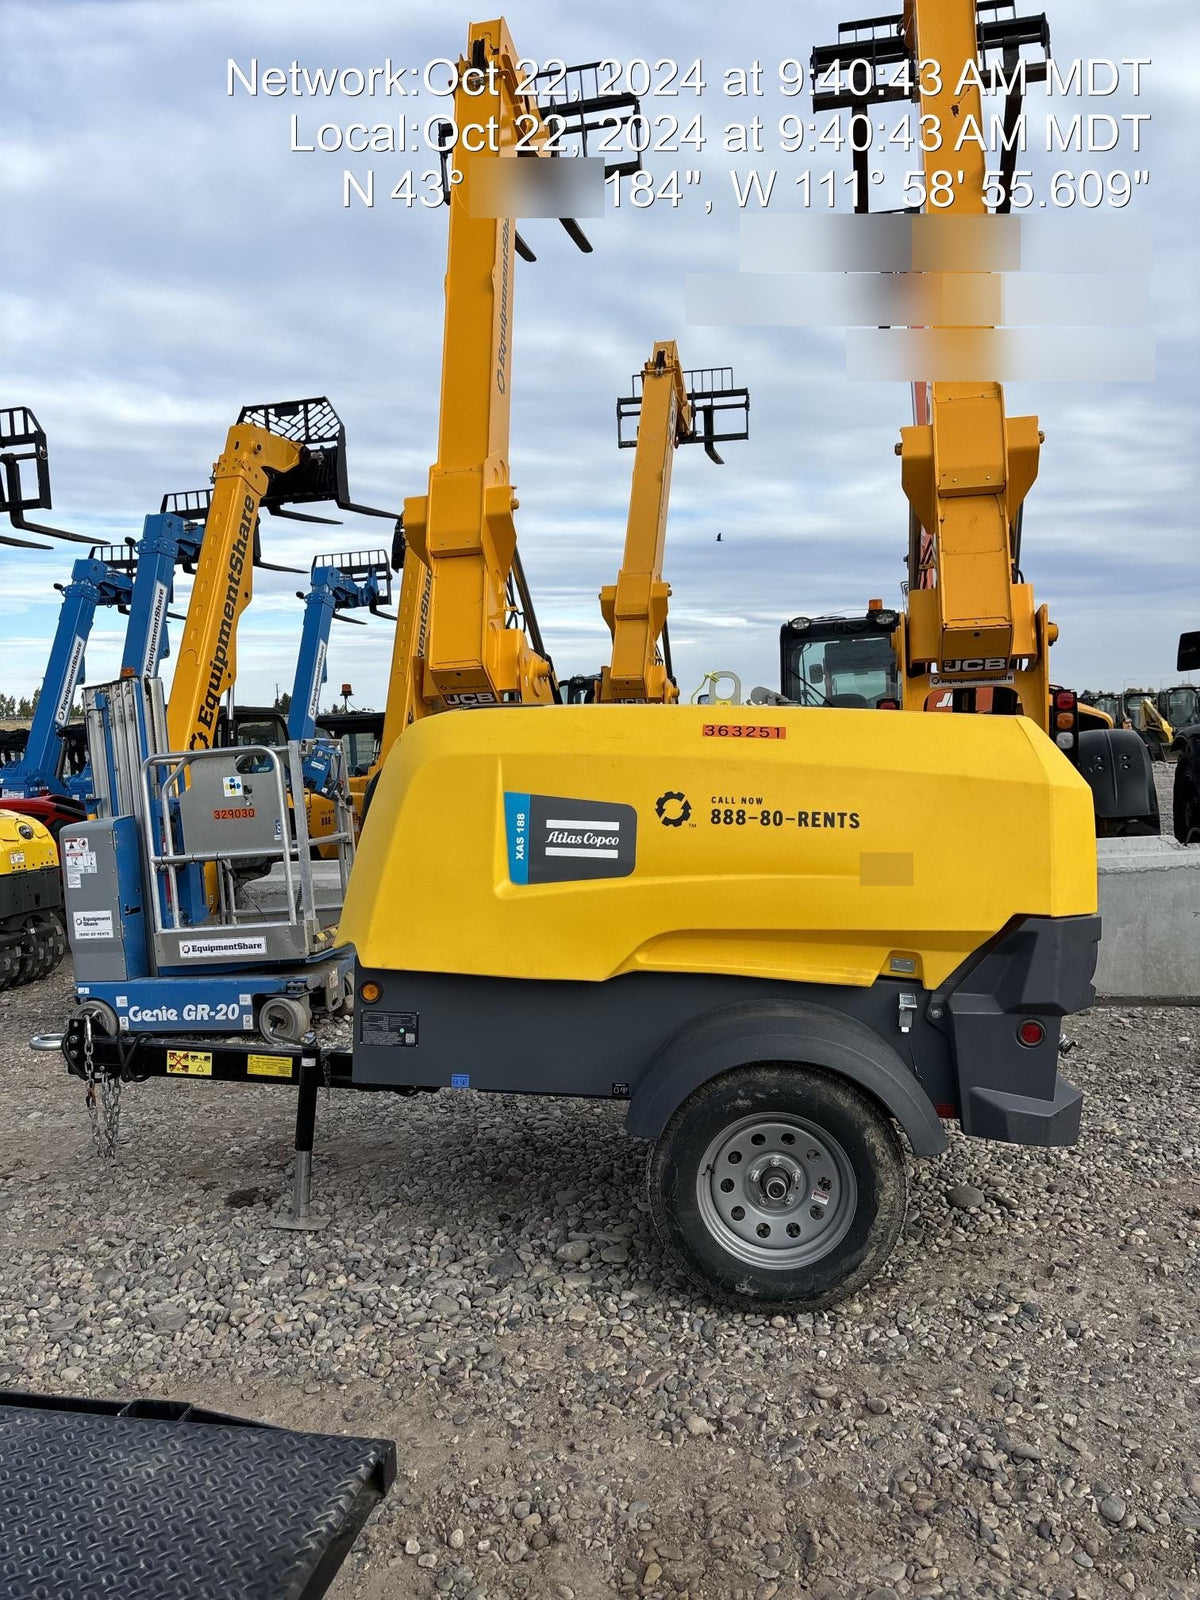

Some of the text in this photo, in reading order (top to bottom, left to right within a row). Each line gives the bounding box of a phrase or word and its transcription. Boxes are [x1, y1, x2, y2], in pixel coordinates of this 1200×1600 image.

[197, 497, 255, 730] EquipmentShare
[145, 588, 165, 675] EquipmentShare
[943, 658, 1006, 673] JCB
[61, 641, 83, 712] EquipmentShare
[446, 692, 496, 705] JCB
[704, 724, 782, 739] 363251
[711, 796, 764, 805] CALL NOW
[214, 808, 255, 820] 329030
[711, 808, 861, 829] 888-80-RENTS
[515, 812, 526, 860] XAS 188
[191, 942, 262, 954] EquipmentShare
[128, 1003, 240, 1022] Genie GR-20
